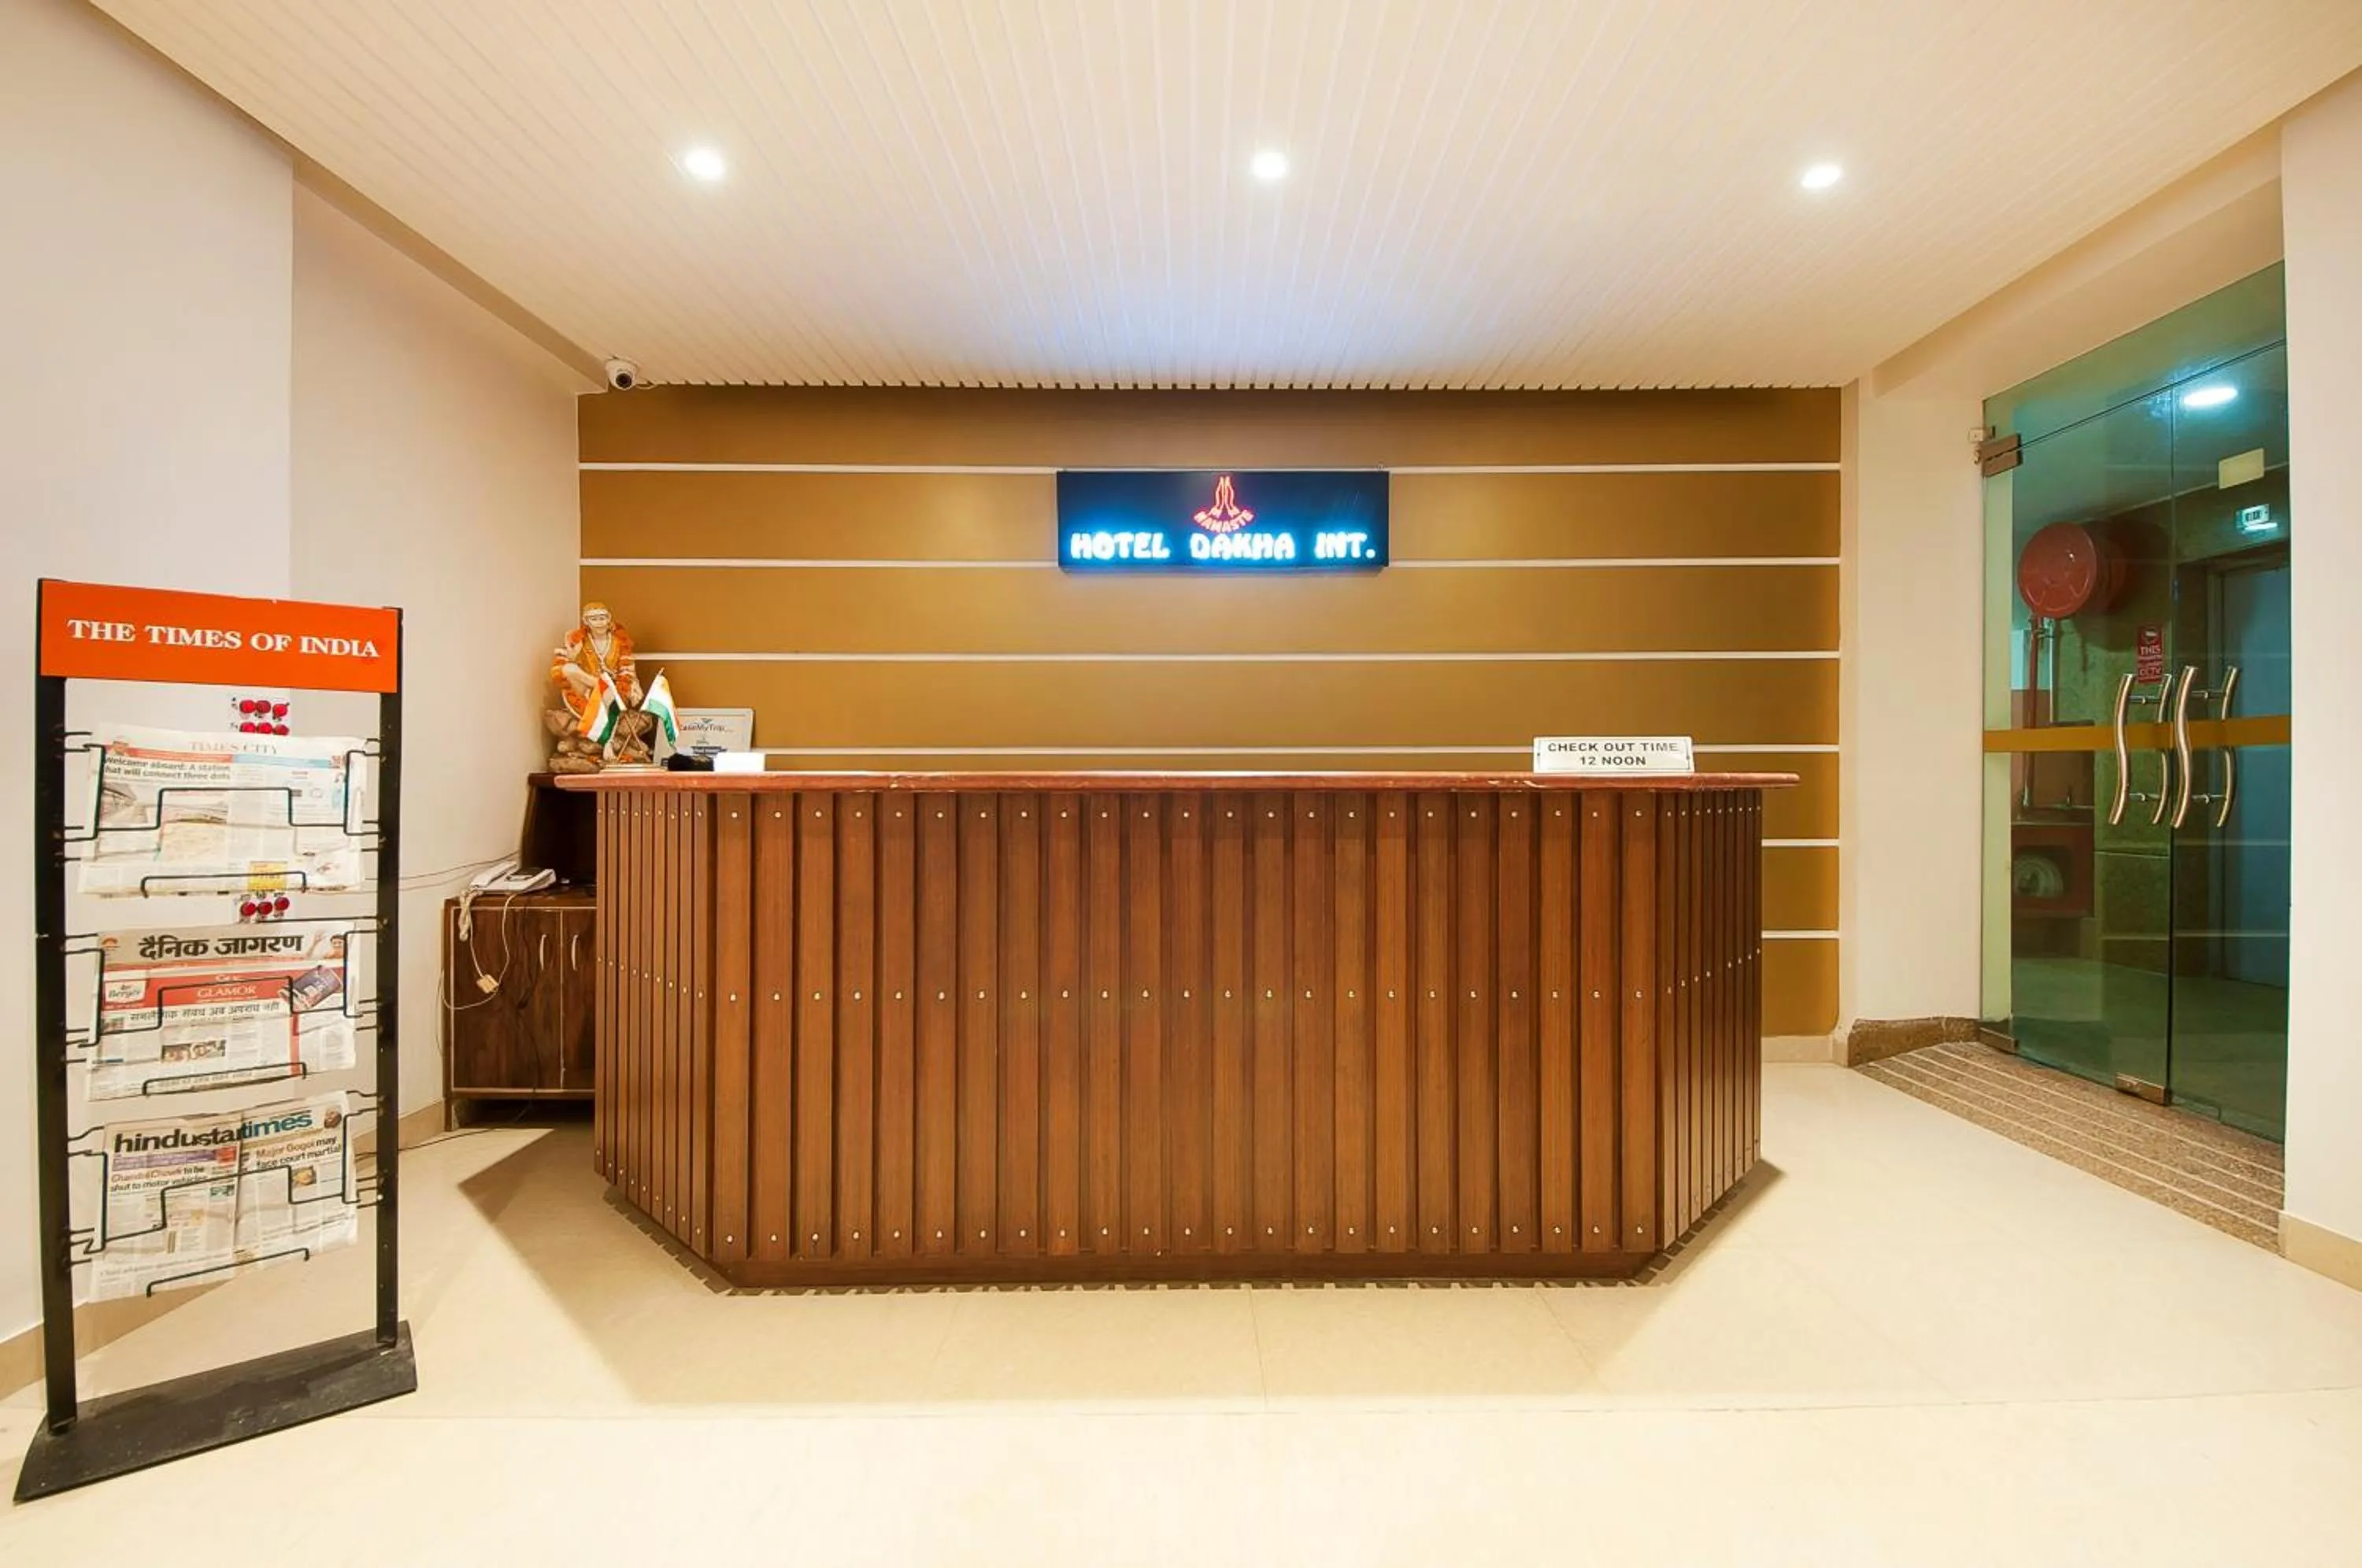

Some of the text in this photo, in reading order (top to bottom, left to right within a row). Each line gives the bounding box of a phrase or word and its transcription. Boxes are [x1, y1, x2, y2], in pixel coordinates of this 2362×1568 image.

[1193, 509, 1254, 533] NAMASTE
[1069, 531, 1171, 560] HOTEL
[1313, 531, 1376, 560] INT.
[66, 619, 379, 658] THE TIMES OF INDIA
[189, 741, 276, 754] TIMES CITY
[1547, 742, 1679, 753] CHECK OUT TIME
[1579, 756, 1647, 766] 12 NOON
[138, 934, 304, 961] दैनिक जागरण
[197, 985, 257, 998] GLAMOR
[316, 1137, 337, 1147] may
[280, 1152, 305, 1164] court
